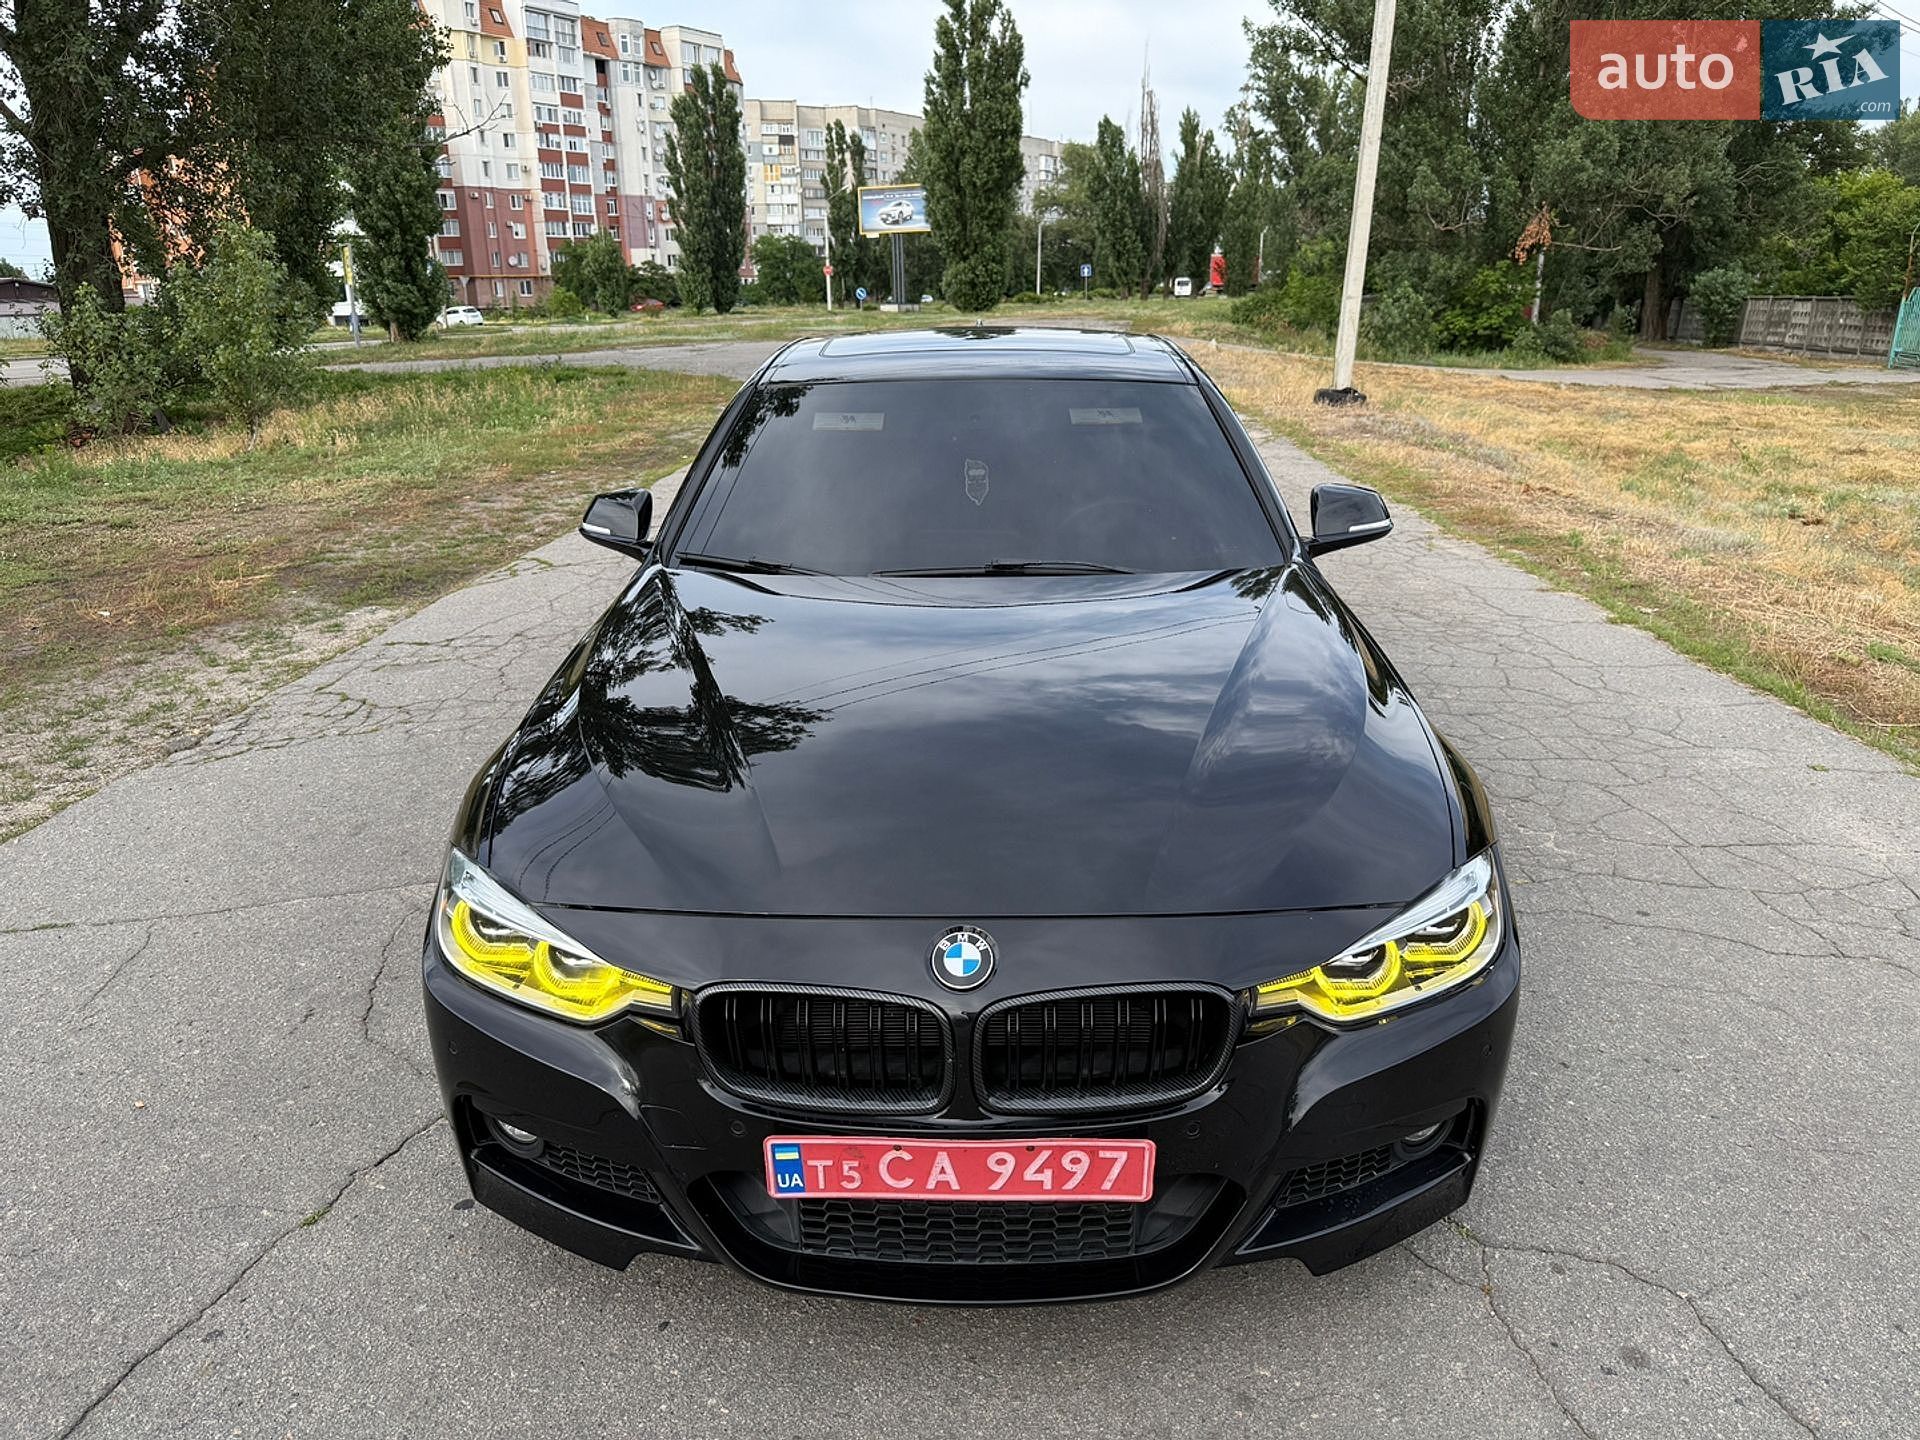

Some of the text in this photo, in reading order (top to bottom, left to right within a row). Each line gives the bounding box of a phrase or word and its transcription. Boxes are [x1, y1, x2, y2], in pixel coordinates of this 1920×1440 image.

[938, 934, 988, 951] BMW
[986, 1149, 1128, 1191] 9497
[777, 1173, 804, 1188] UA
